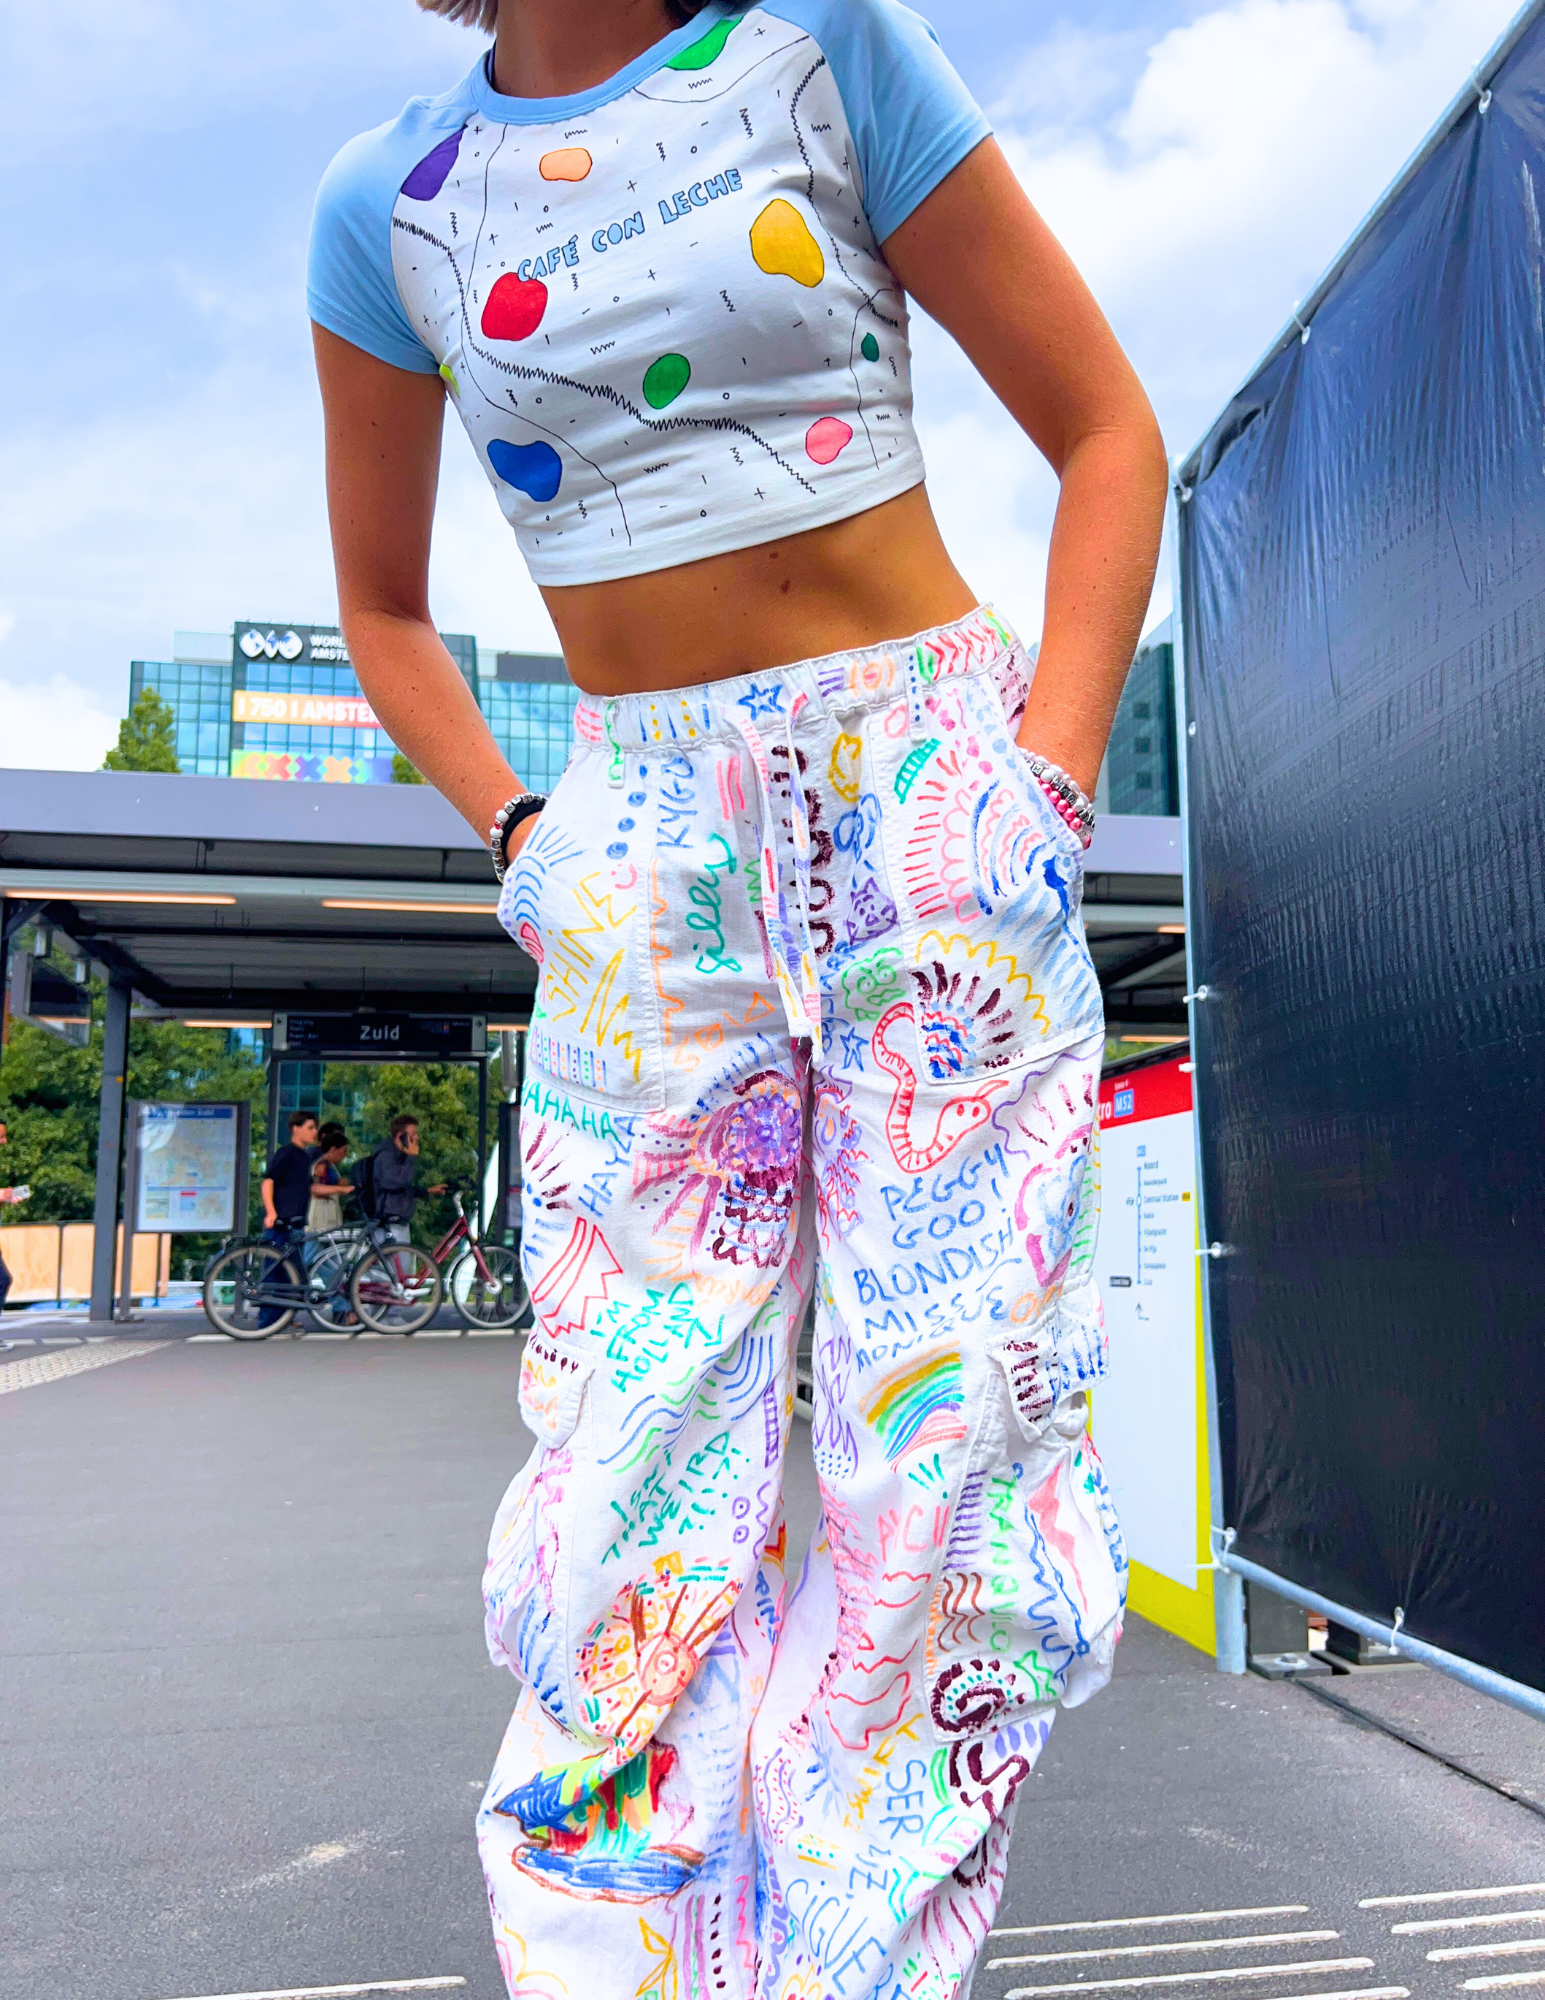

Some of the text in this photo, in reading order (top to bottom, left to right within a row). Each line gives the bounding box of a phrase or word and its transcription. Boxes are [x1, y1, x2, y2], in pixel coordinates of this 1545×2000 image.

[517, 168, 743, 283] CAFÉ CON LECHE
[309, 634, 346, 648] WORL
[309, 648, 350, 662] AMSTE
[250, 697, 288, 719] 750
[359, 1024, 400, 1041] Zuid
[1115, 1094, 1133, 1113] M52
[880, 1143, 1009, 1220] PEGGY
[853, 1216, 1013, 1305] BLONDISH
[606, 1288, 666, 1362] FROM
